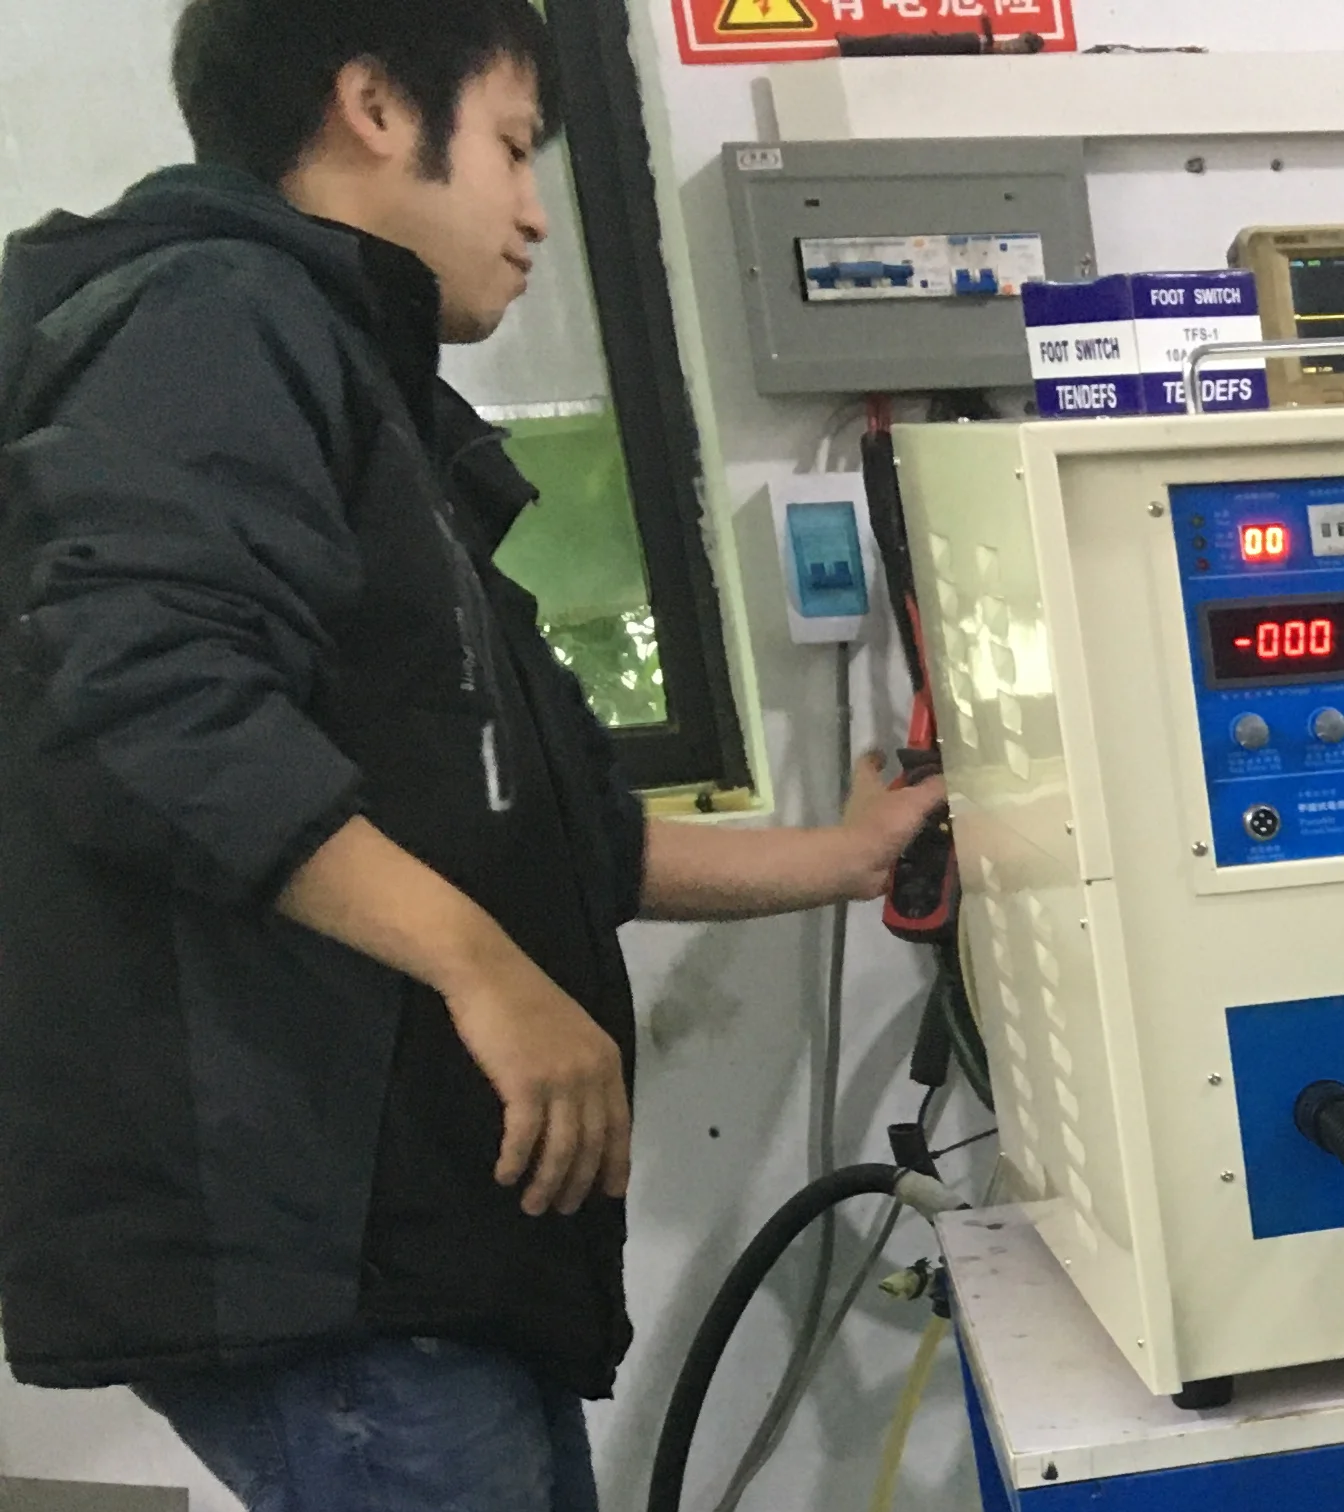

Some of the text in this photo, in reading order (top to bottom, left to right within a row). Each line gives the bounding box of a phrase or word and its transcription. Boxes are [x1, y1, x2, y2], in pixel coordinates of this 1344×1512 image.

[1150, 287, 1241, 306] FOOT SWITCH
[1183, 327, 1219, 341] TFS-1
[1040, 338, 1120, 363] FOOT SWITCH
[1056, 382, 1117, 410] TENDEFS
[1162, 378, 1252, 403] TEDEFS
[1245, 526, 1284, 556] 00
[1234, 619, 1332, 658] -000
